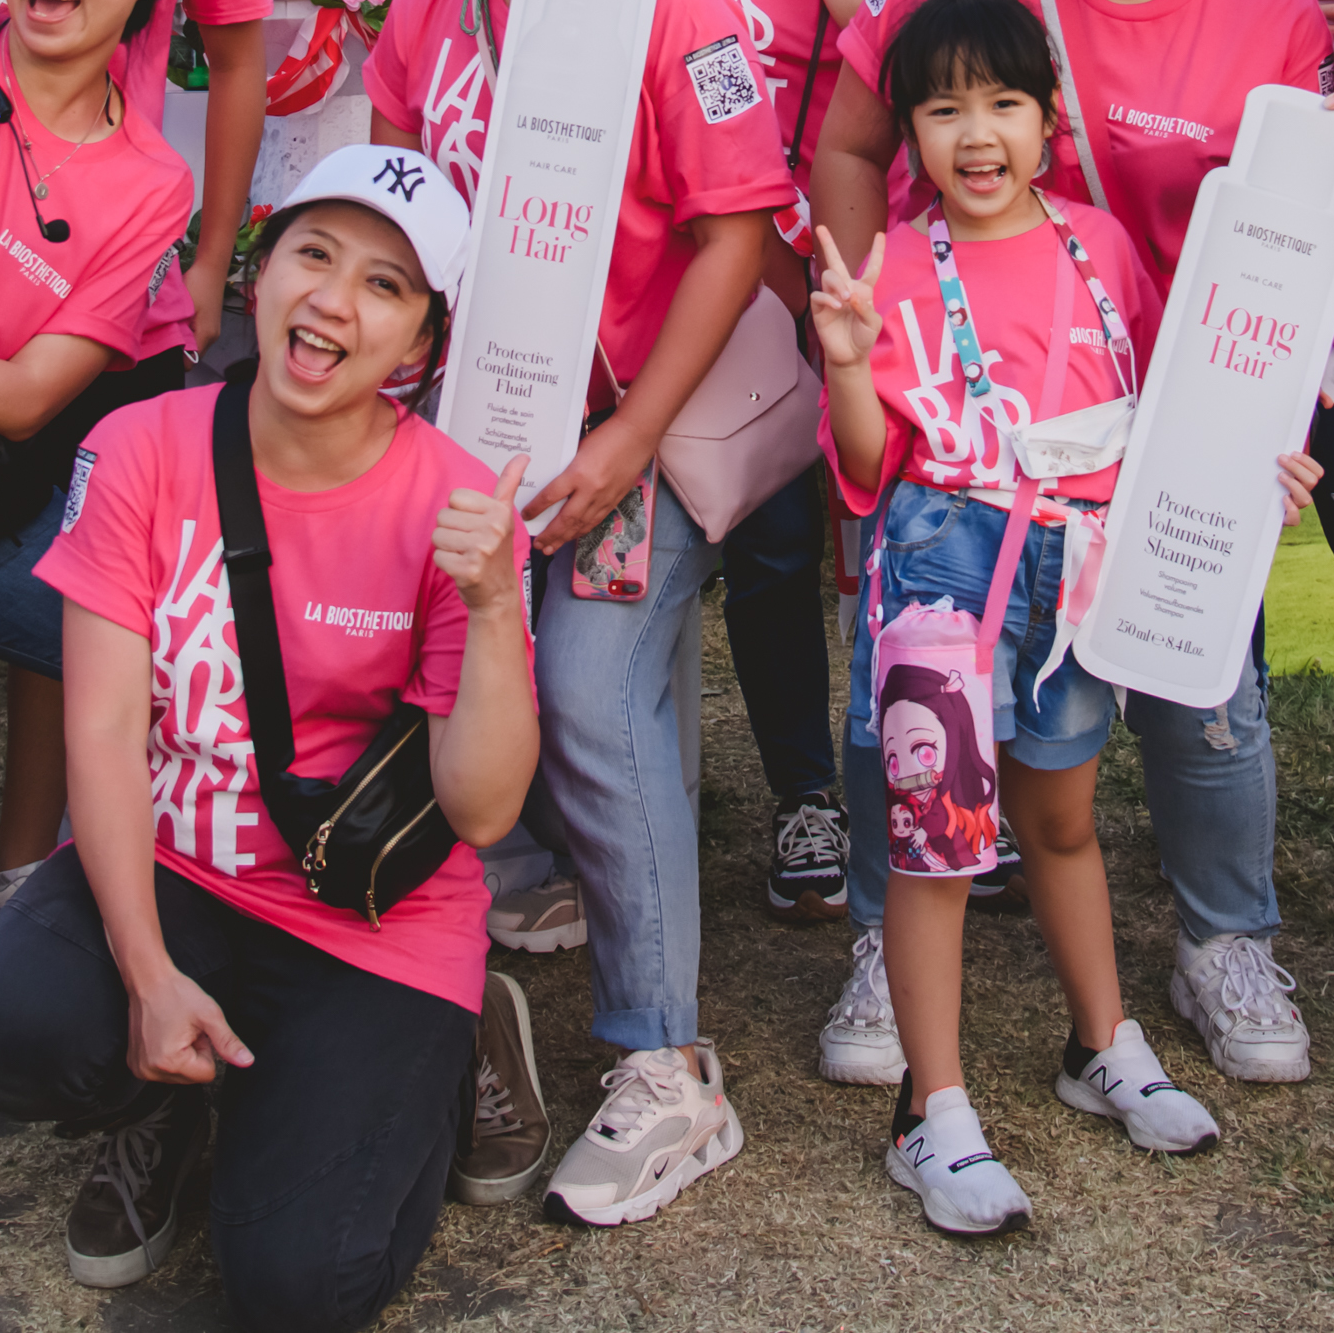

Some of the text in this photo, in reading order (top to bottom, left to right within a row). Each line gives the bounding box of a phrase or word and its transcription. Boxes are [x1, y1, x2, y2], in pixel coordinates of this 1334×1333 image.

[517, 114, 528, 130] LA
[1108, 104, 1124, 122] LA
[547, 134, 569, 144] PARIS
[1144, 128, 1169, 138] PARIS
[529, 160, 577, 176] HAIR CARE
[498, 175, 593, 243] Long
[1233, 219, 1246, 234] LA
[509, 225, 572, 264] Hair
[19, 267, 41, 287] PARIS
[1240, 271, 1284, 291] HAIR CARE
[1199, 282, 1299, 361] Long
[487, 341, 553, 367] Protective
[1208, 334, 1273, 380] Hair
[476, 357, 559, 386] Conditioning
[495, 378, 533, 398] Fluid
[487, 403, 534, 419] Fluide de soin
[491, 415, 527, 427] protecteur
[478, 436, 531, 453] Haarpflegefluid
[485, 428, 528, 443] Schützendes
[1157, 490, 1237, 532] Protective
[1148, 511, 1234, 557] Volumising
[1144, 536, 1223, 575] Shampoo
[304, 601, 323, 622] LA
[345, 628, 374, 638] PARIS
[1116, 618, 1183, 652] 250 ml 8.4
